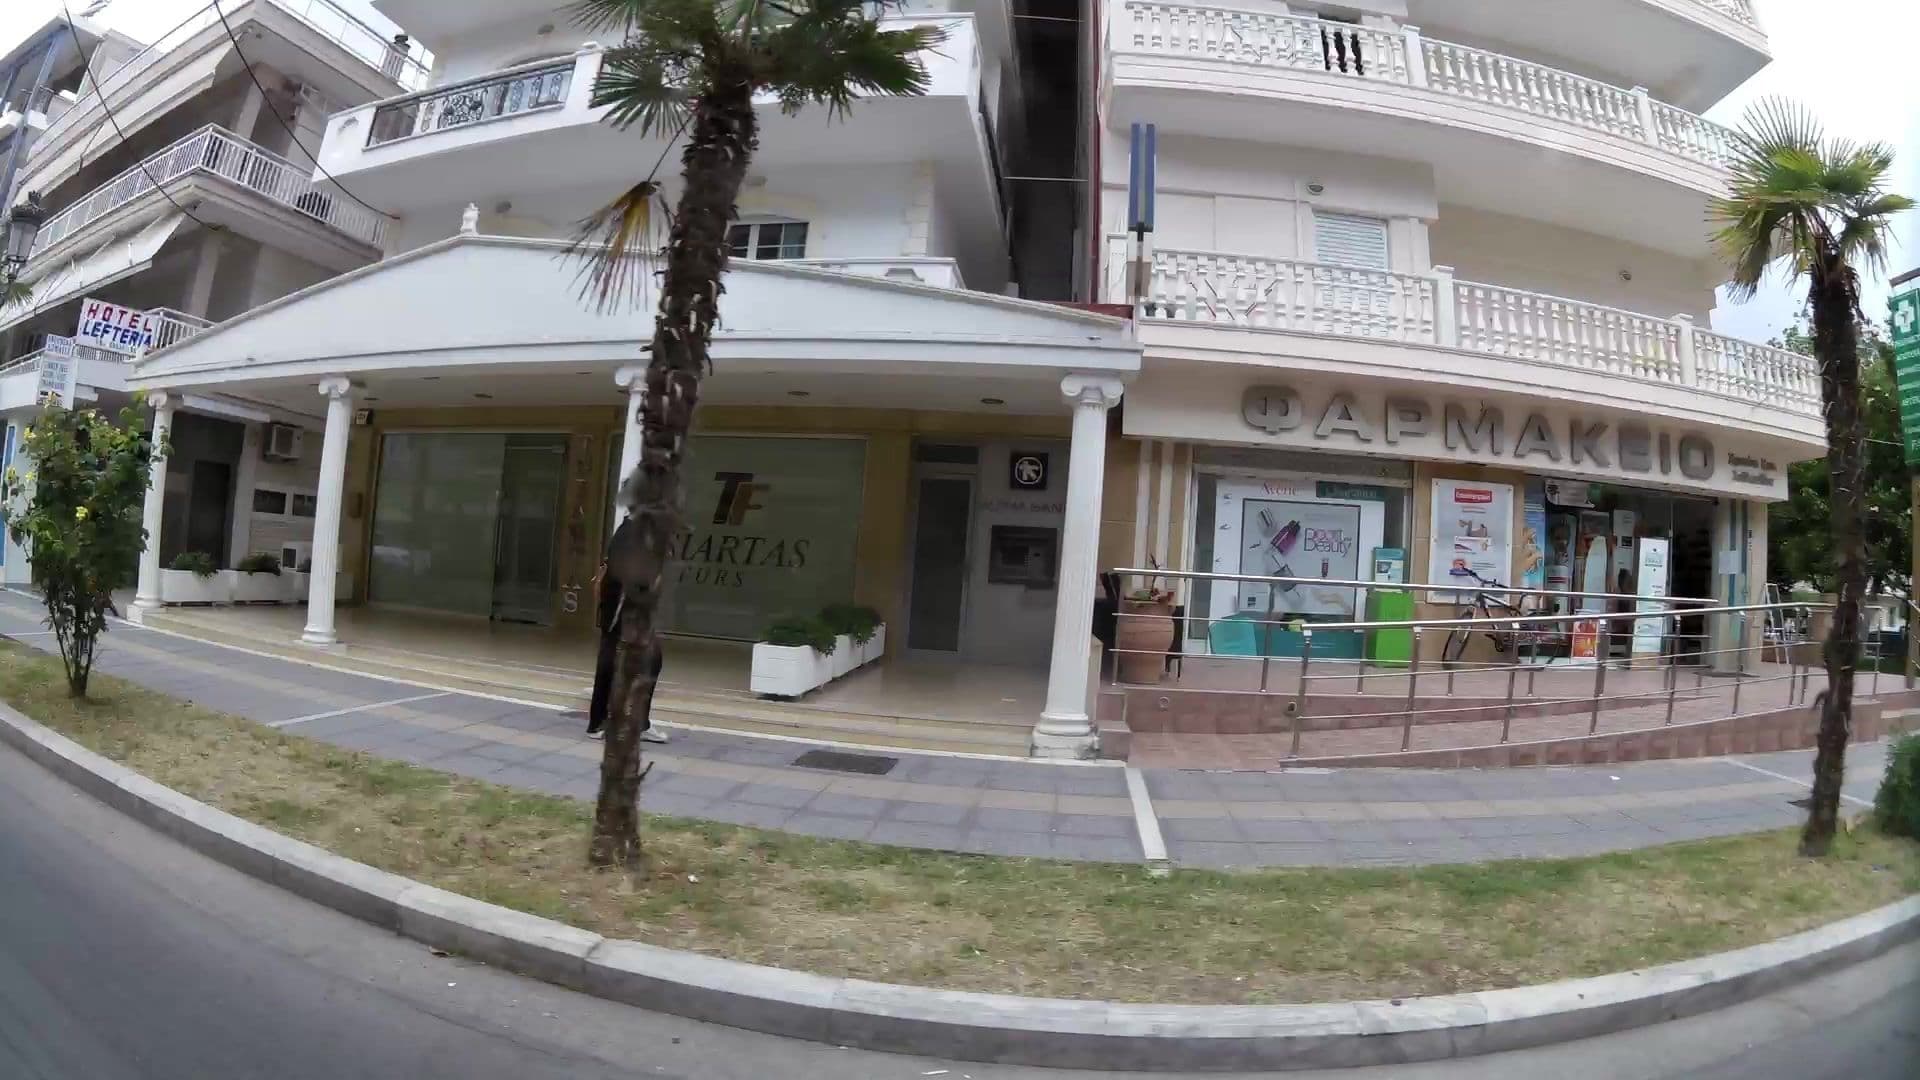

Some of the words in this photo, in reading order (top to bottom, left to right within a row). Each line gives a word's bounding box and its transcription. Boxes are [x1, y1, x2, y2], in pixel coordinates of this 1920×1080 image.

[87, 303, 152, 332] HOTEL
[82, 319, 152, 347] LEFTERIA
[1241, 383, 1716, 482] ΦΑΡΜΑΚΕΙΟ
[1304, 538, 1352, 557] Beauty
